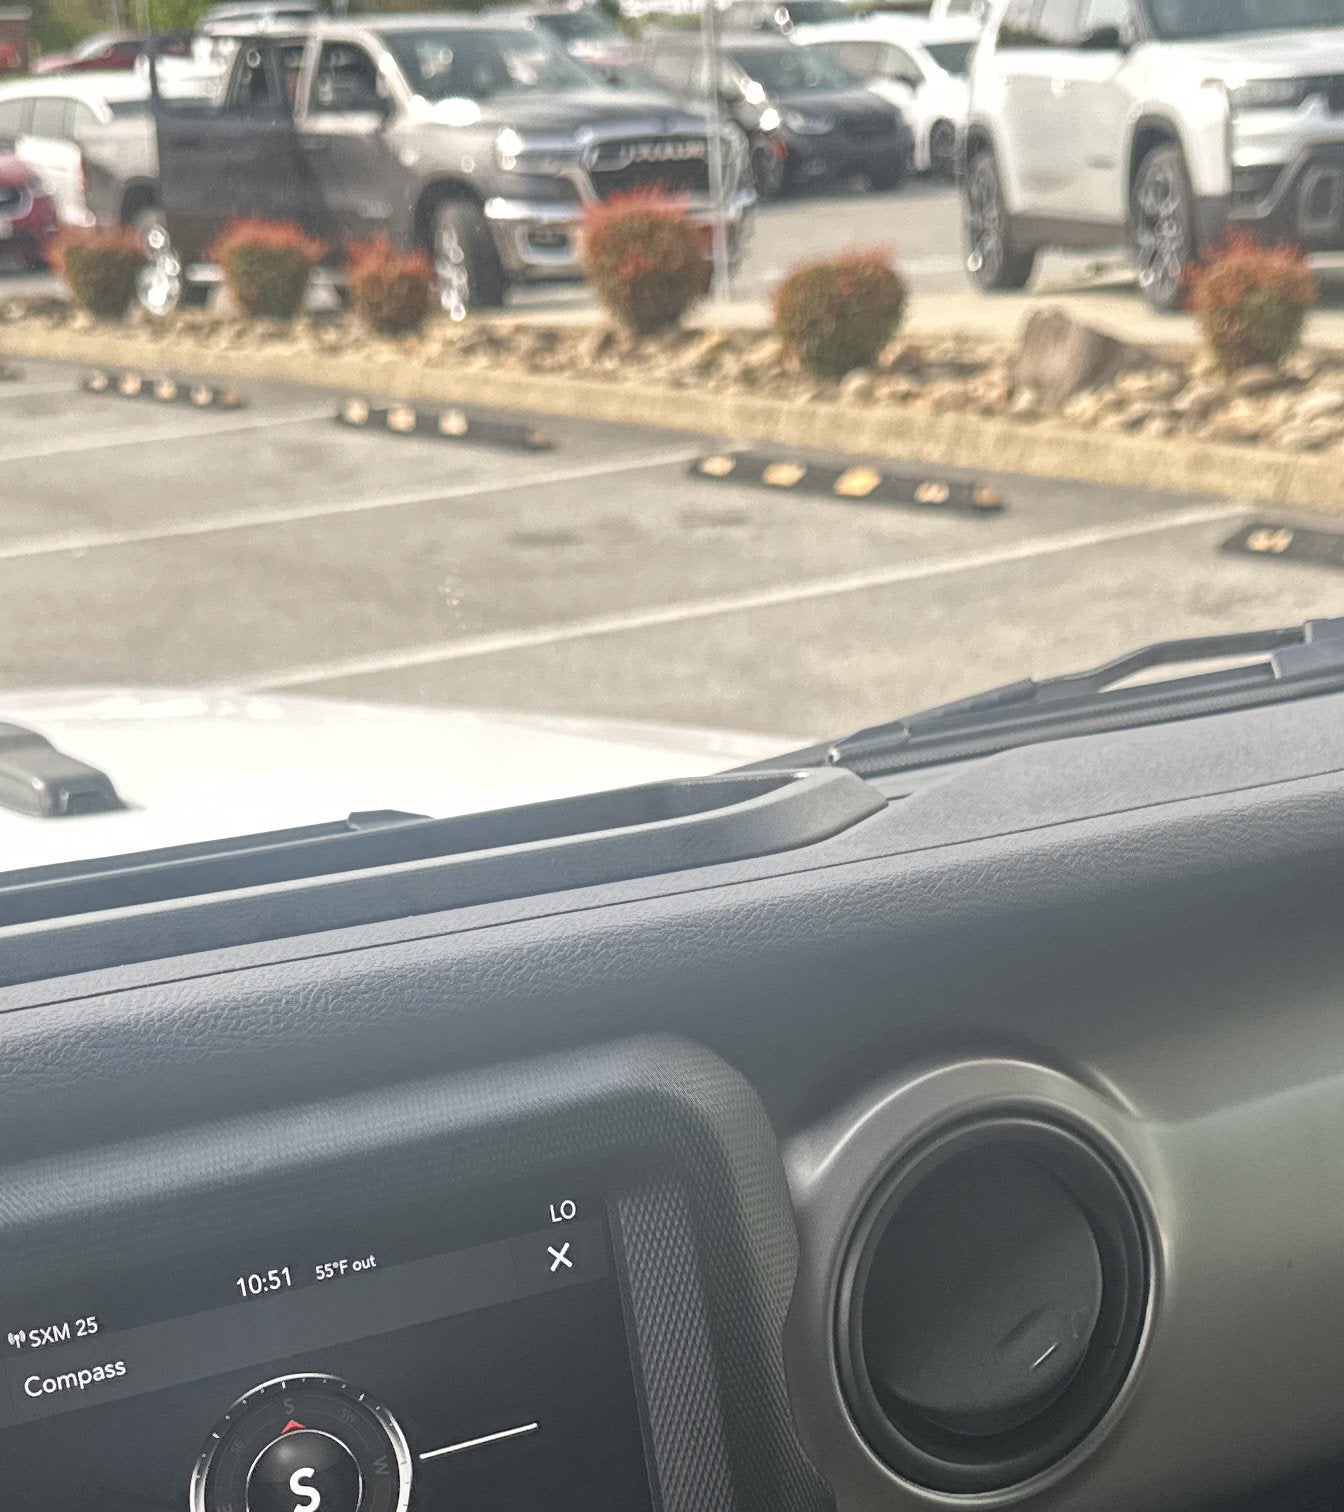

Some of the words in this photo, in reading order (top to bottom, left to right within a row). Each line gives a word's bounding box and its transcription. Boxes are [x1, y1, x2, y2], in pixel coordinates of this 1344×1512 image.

[548, 1199, 578, 1223] LO
[235, 1267, 294, 1298] 10:51
[352, 1254, 377, 1273] out
[28, 1322, 71, 1348] SXM
[74, 1316, 99, 1337] 25
[23, 1360, 127, 1398] Compass
